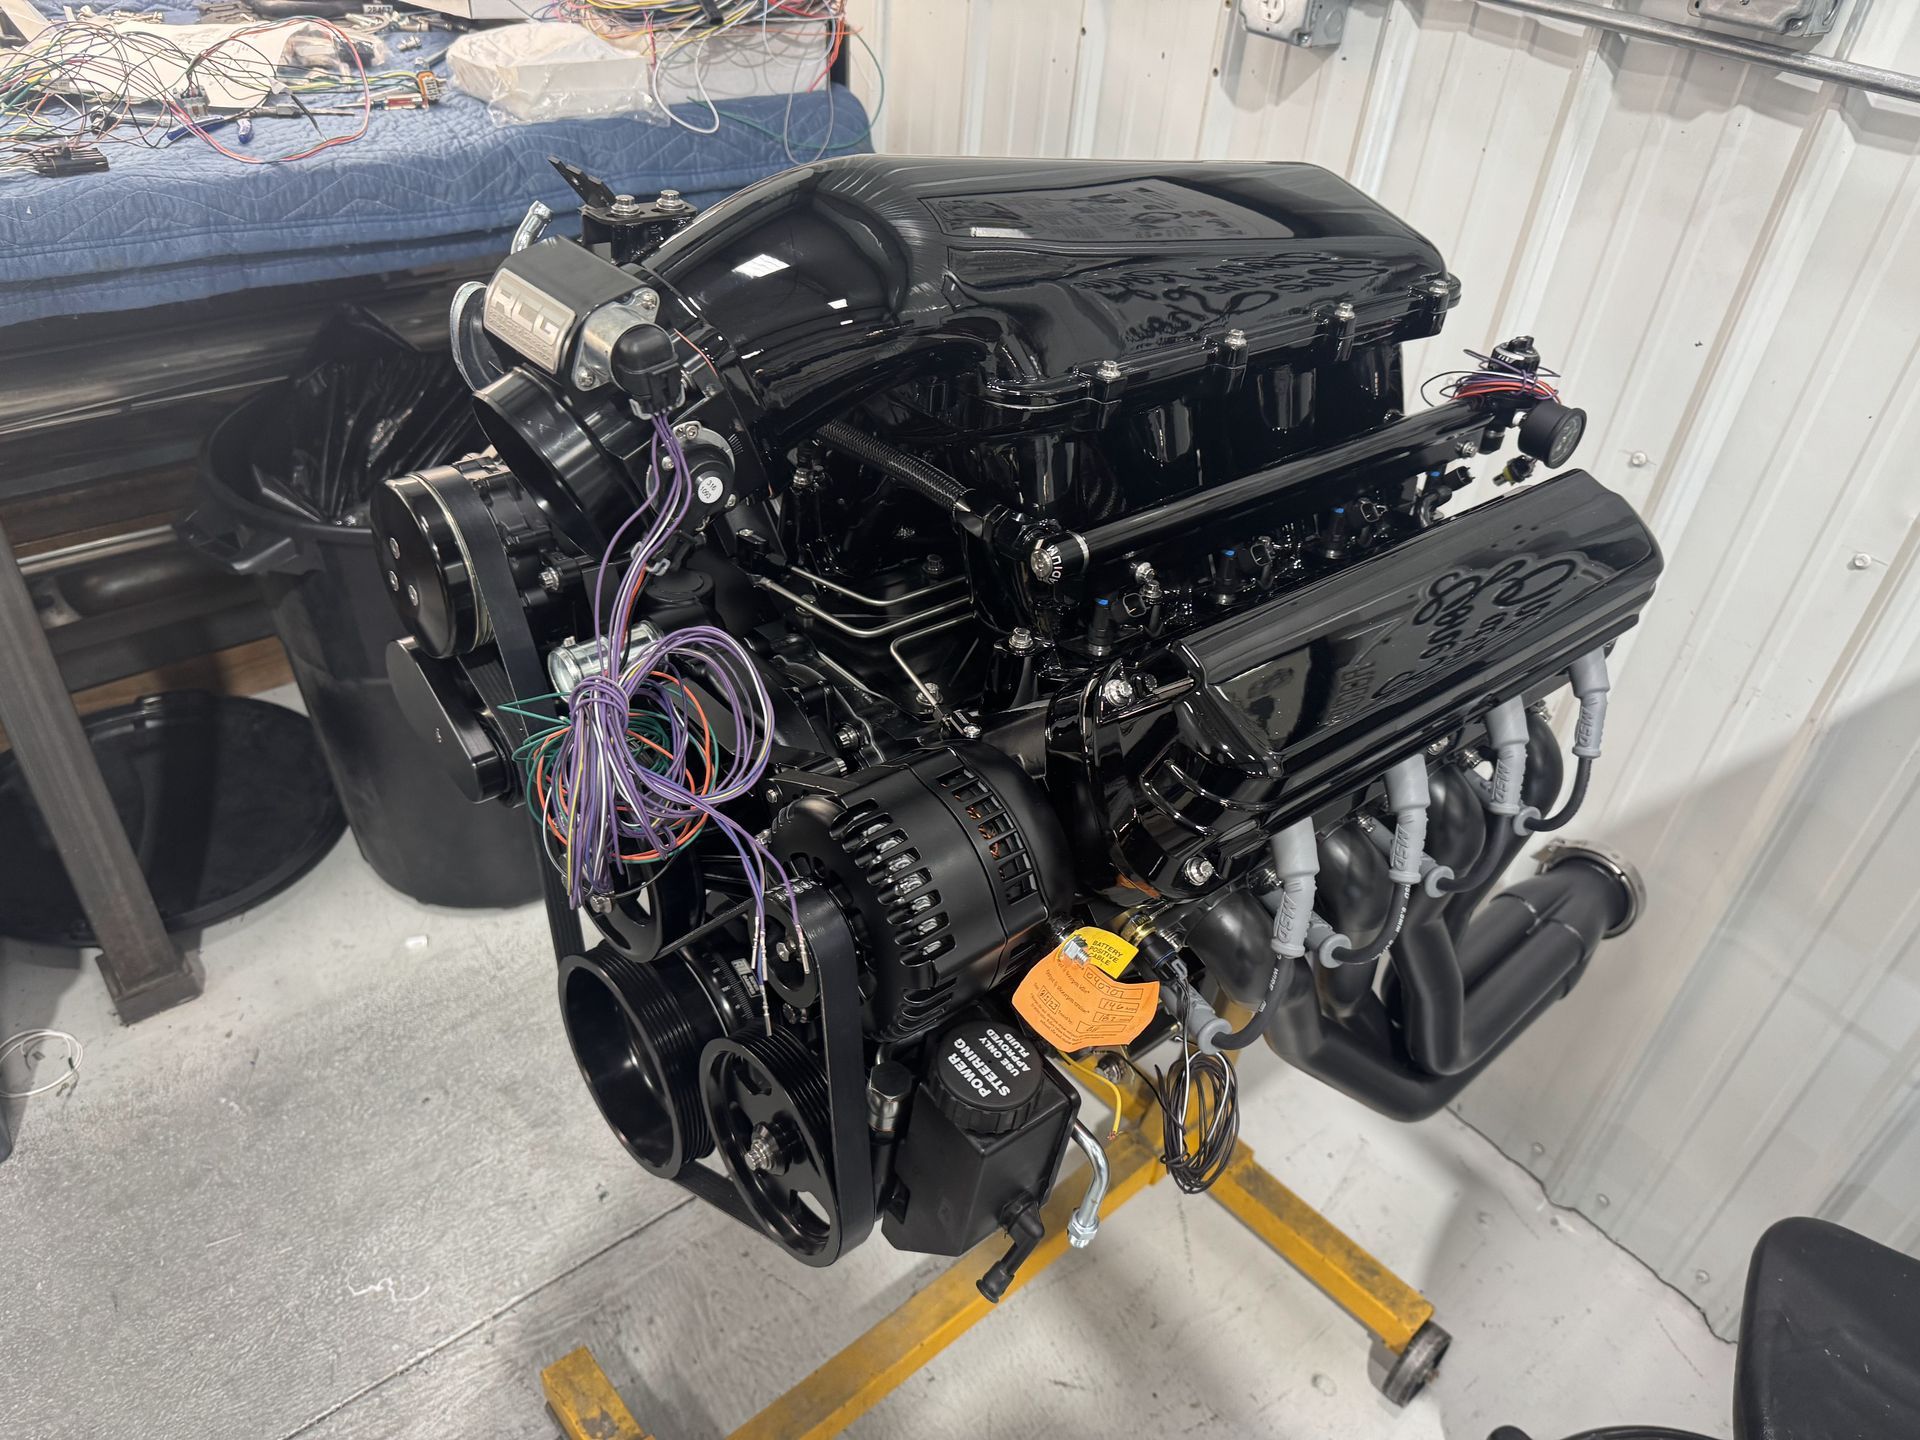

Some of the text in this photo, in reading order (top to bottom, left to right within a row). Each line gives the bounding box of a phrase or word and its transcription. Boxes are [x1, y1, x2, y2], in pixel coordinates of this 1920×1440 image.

[1578, 707, 1594, 747] MSD
[1495, 760, 1511, 803] MSD
[1395, 826, 1410, 871] MSD
[1277, 893, 1297, 943] MSD
[1088, 945, 1120, 964] POSITIVE
[1088, 952, 1112, 967] CABLE
[1092, 939, 1123, 958] BATTERY
[979, 1036, 1020, 1077] USE ONLY
[986, 1028, 1031, 1072] APPROVED
[1004, 1033, 1030, 1058] FLUID
[948, 1053, 991, 1098] POWER
[953, 1038, 1011, 1096] STEERING
